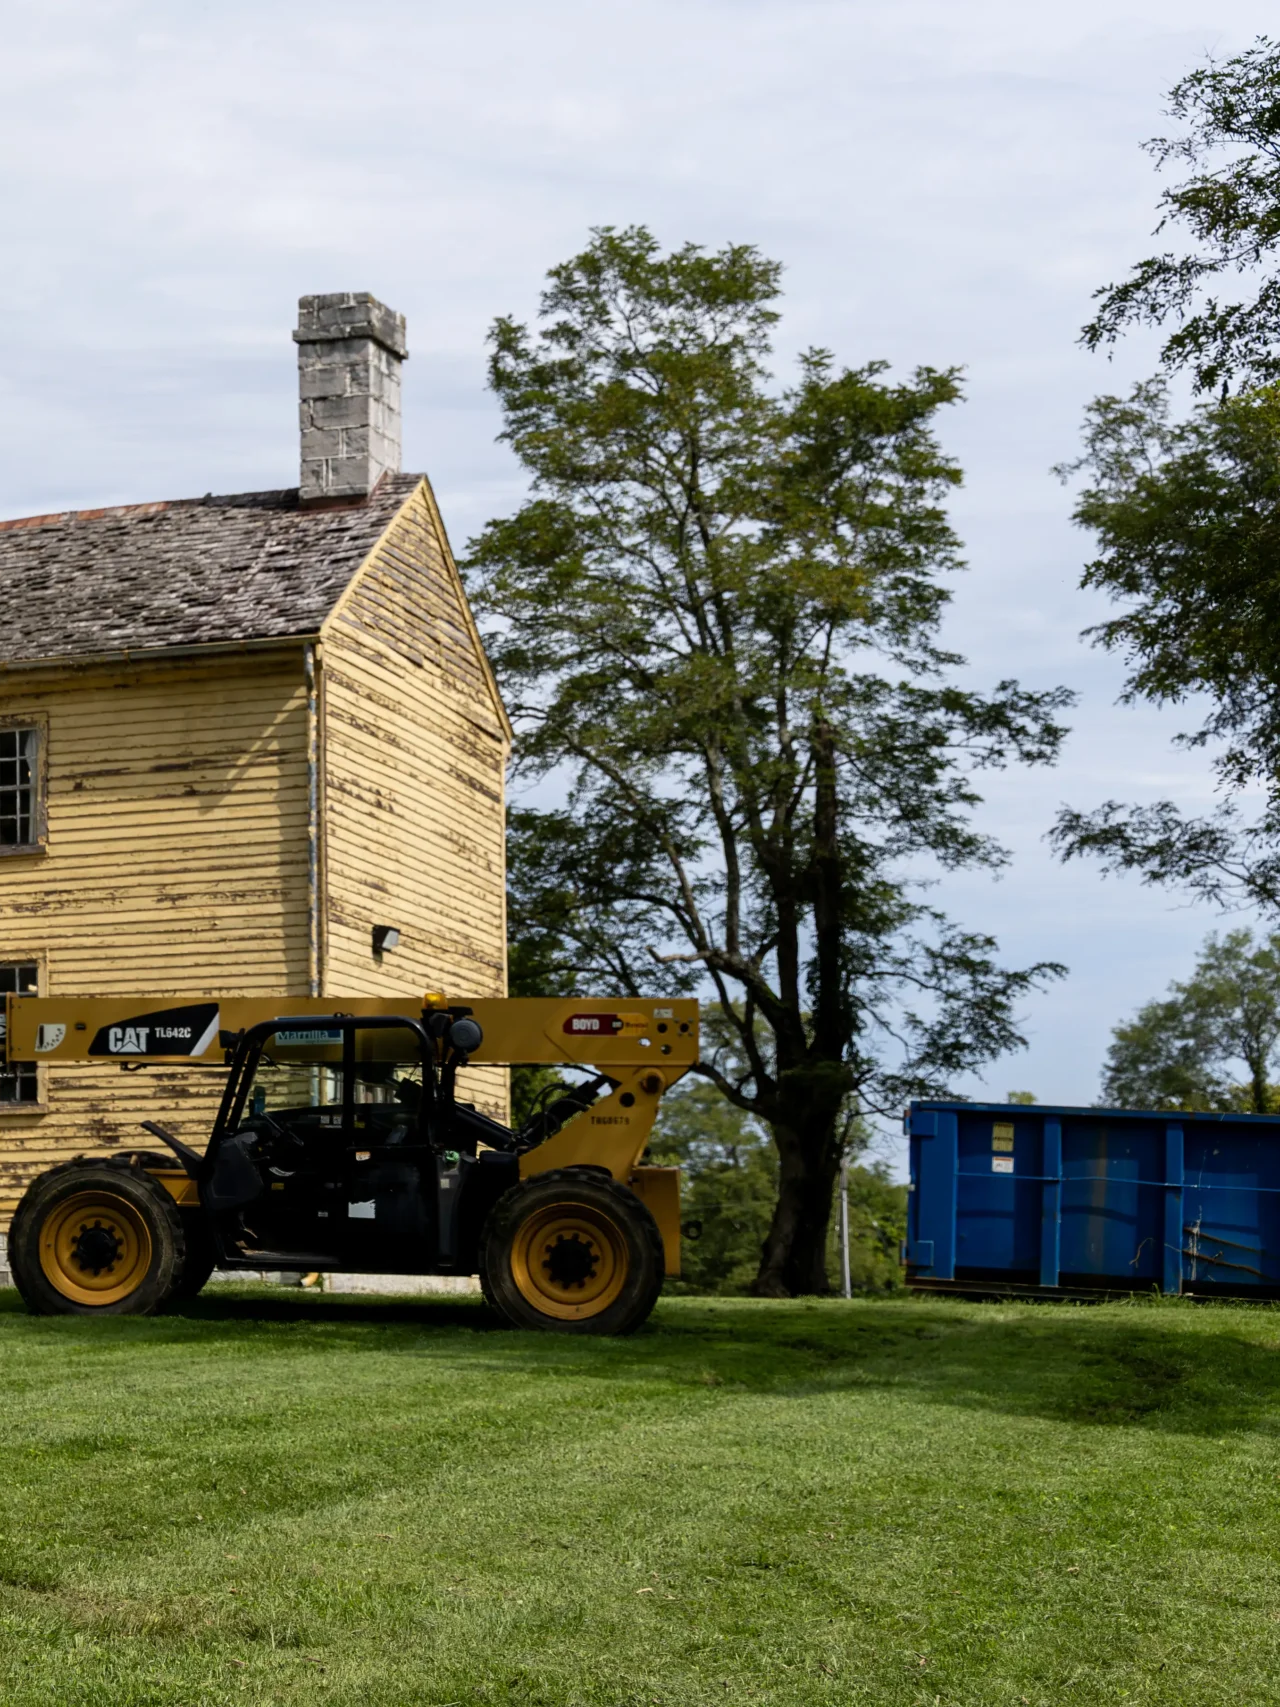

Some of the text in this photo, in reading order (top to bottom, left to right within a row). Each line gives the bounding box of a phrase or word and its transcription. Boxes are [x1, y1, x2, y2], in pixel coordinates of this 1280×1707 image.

[572, 1018, 600, 1031] BOYD
[108, 1027, 192, 1053] CAT TL642C
